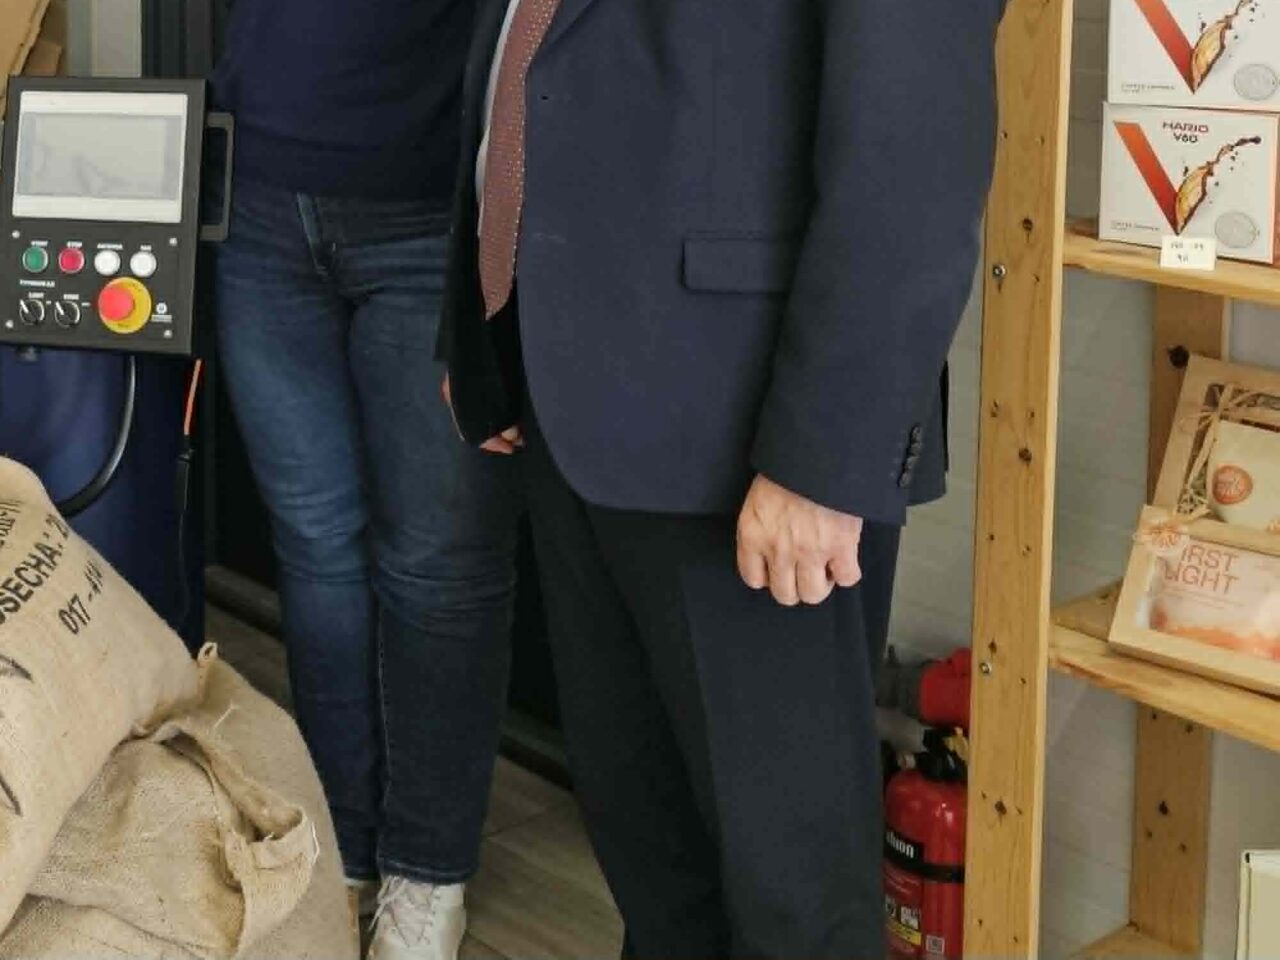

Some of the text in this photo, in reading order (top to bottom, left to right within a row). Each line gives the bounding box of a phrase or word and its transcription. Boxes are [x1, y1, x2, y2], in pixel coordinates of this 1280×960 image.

[1162, 121, 1210, 133] HARIO
[1172, 133, 1199, 143] V60
[1180, 543, 1240, 573] IRST
